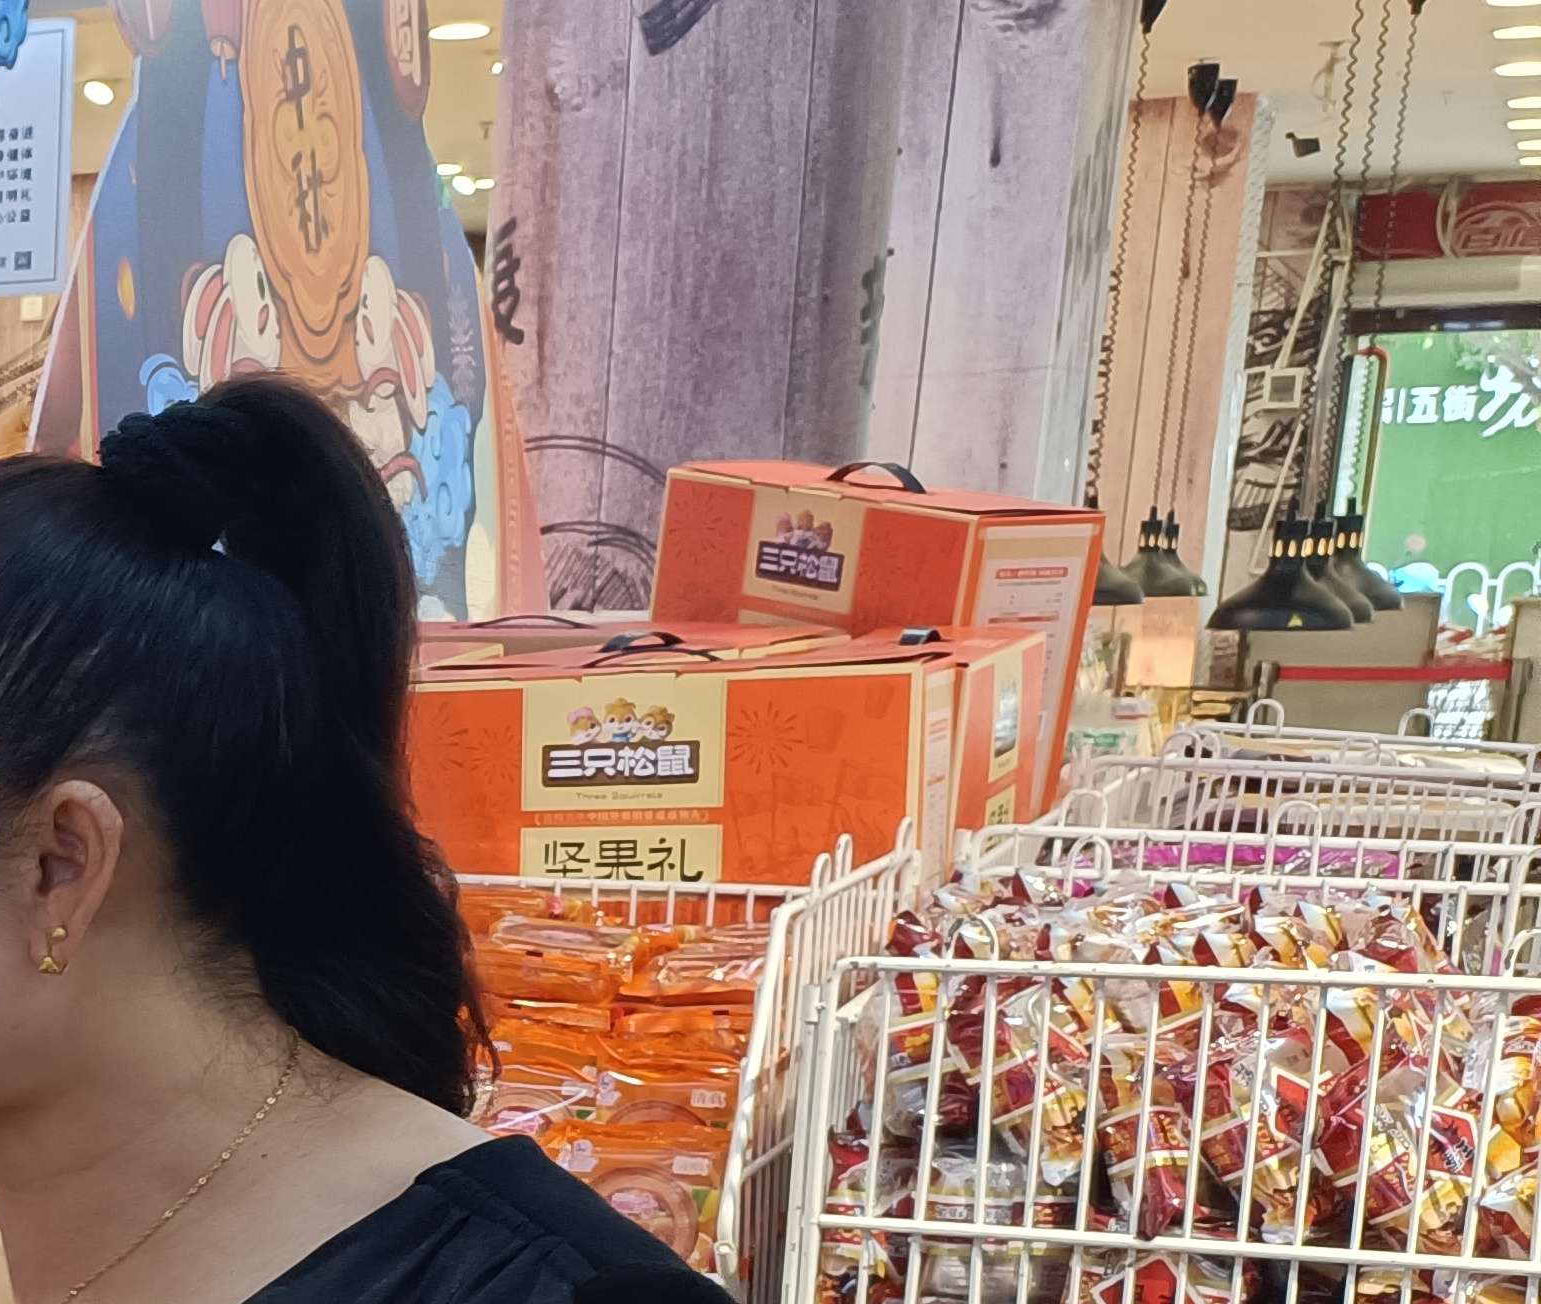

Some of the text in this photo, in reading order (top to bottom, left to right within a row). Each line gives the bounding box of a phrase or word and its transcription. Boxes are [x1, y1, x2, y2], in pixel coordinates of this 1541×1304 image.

[547, 744, 695, 779] 三只松鼠
[543, 837, 705, 882] 坚果礼
